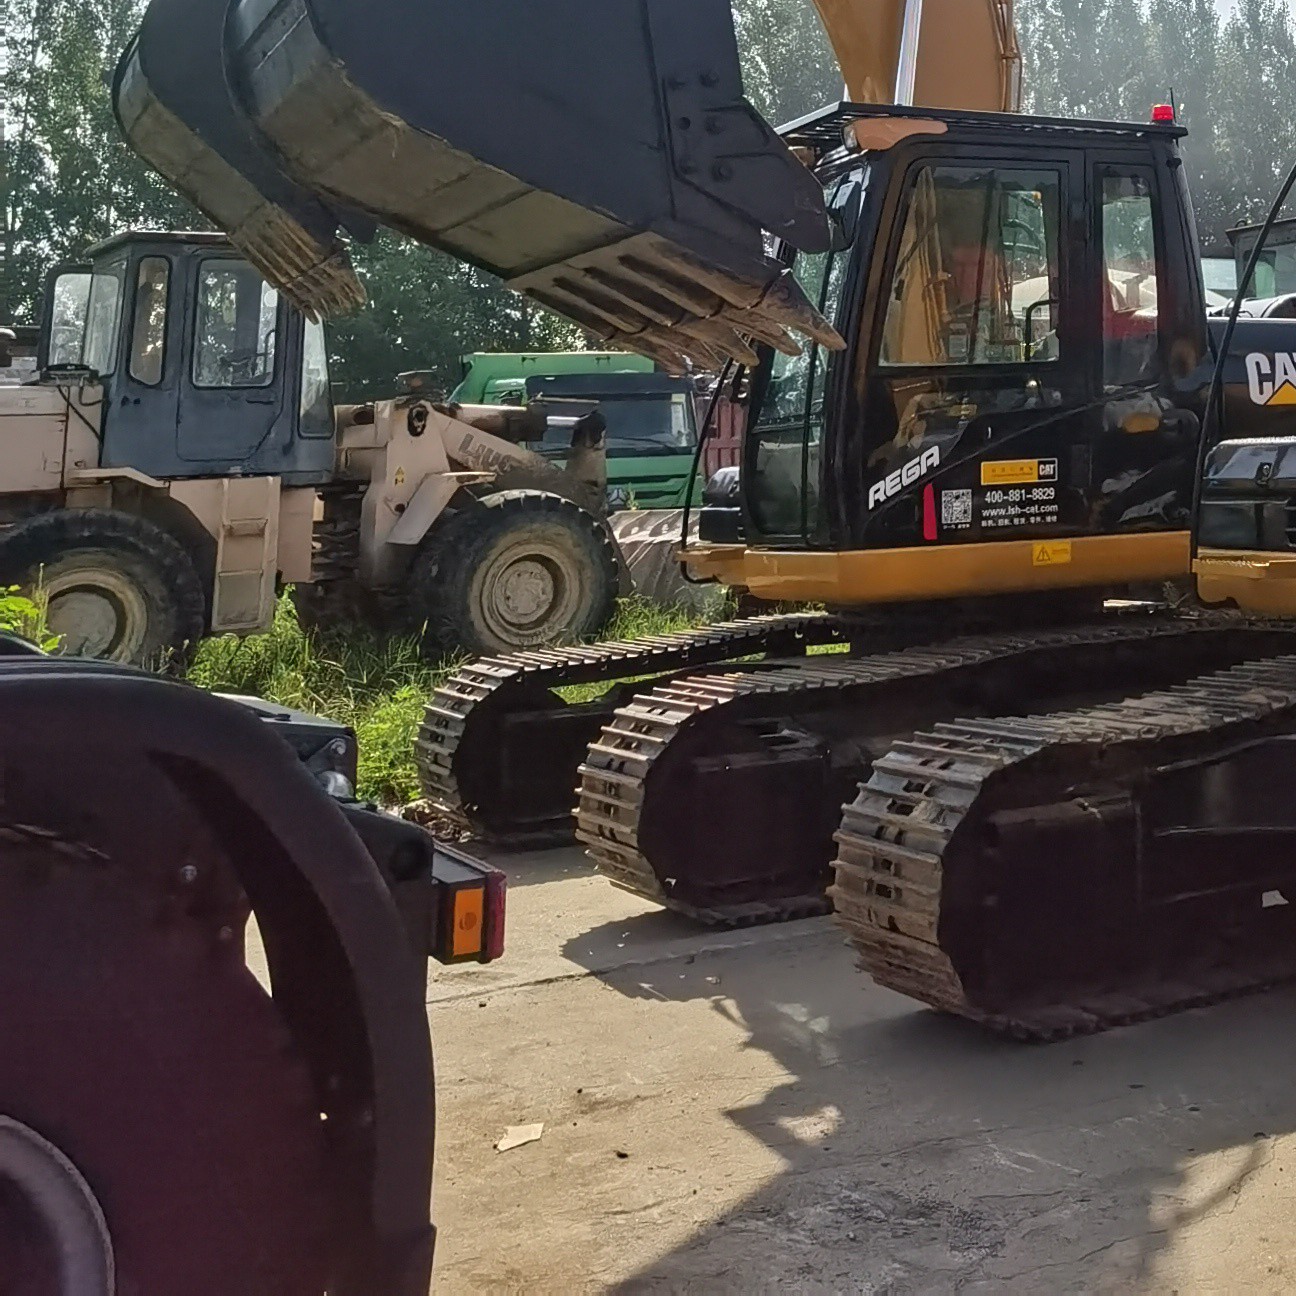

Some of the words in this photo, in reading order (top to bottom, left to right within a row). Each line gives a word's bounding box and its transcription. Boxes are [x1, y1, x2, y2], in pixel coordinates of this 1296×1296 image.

[1039, 464, 1054, 475] CAT
[867, 445, 940, 512] REGA
[985, 487, 1056, 504] 400-881-8829
[982, 504, 1058, 517] www.lsh-cat.com
